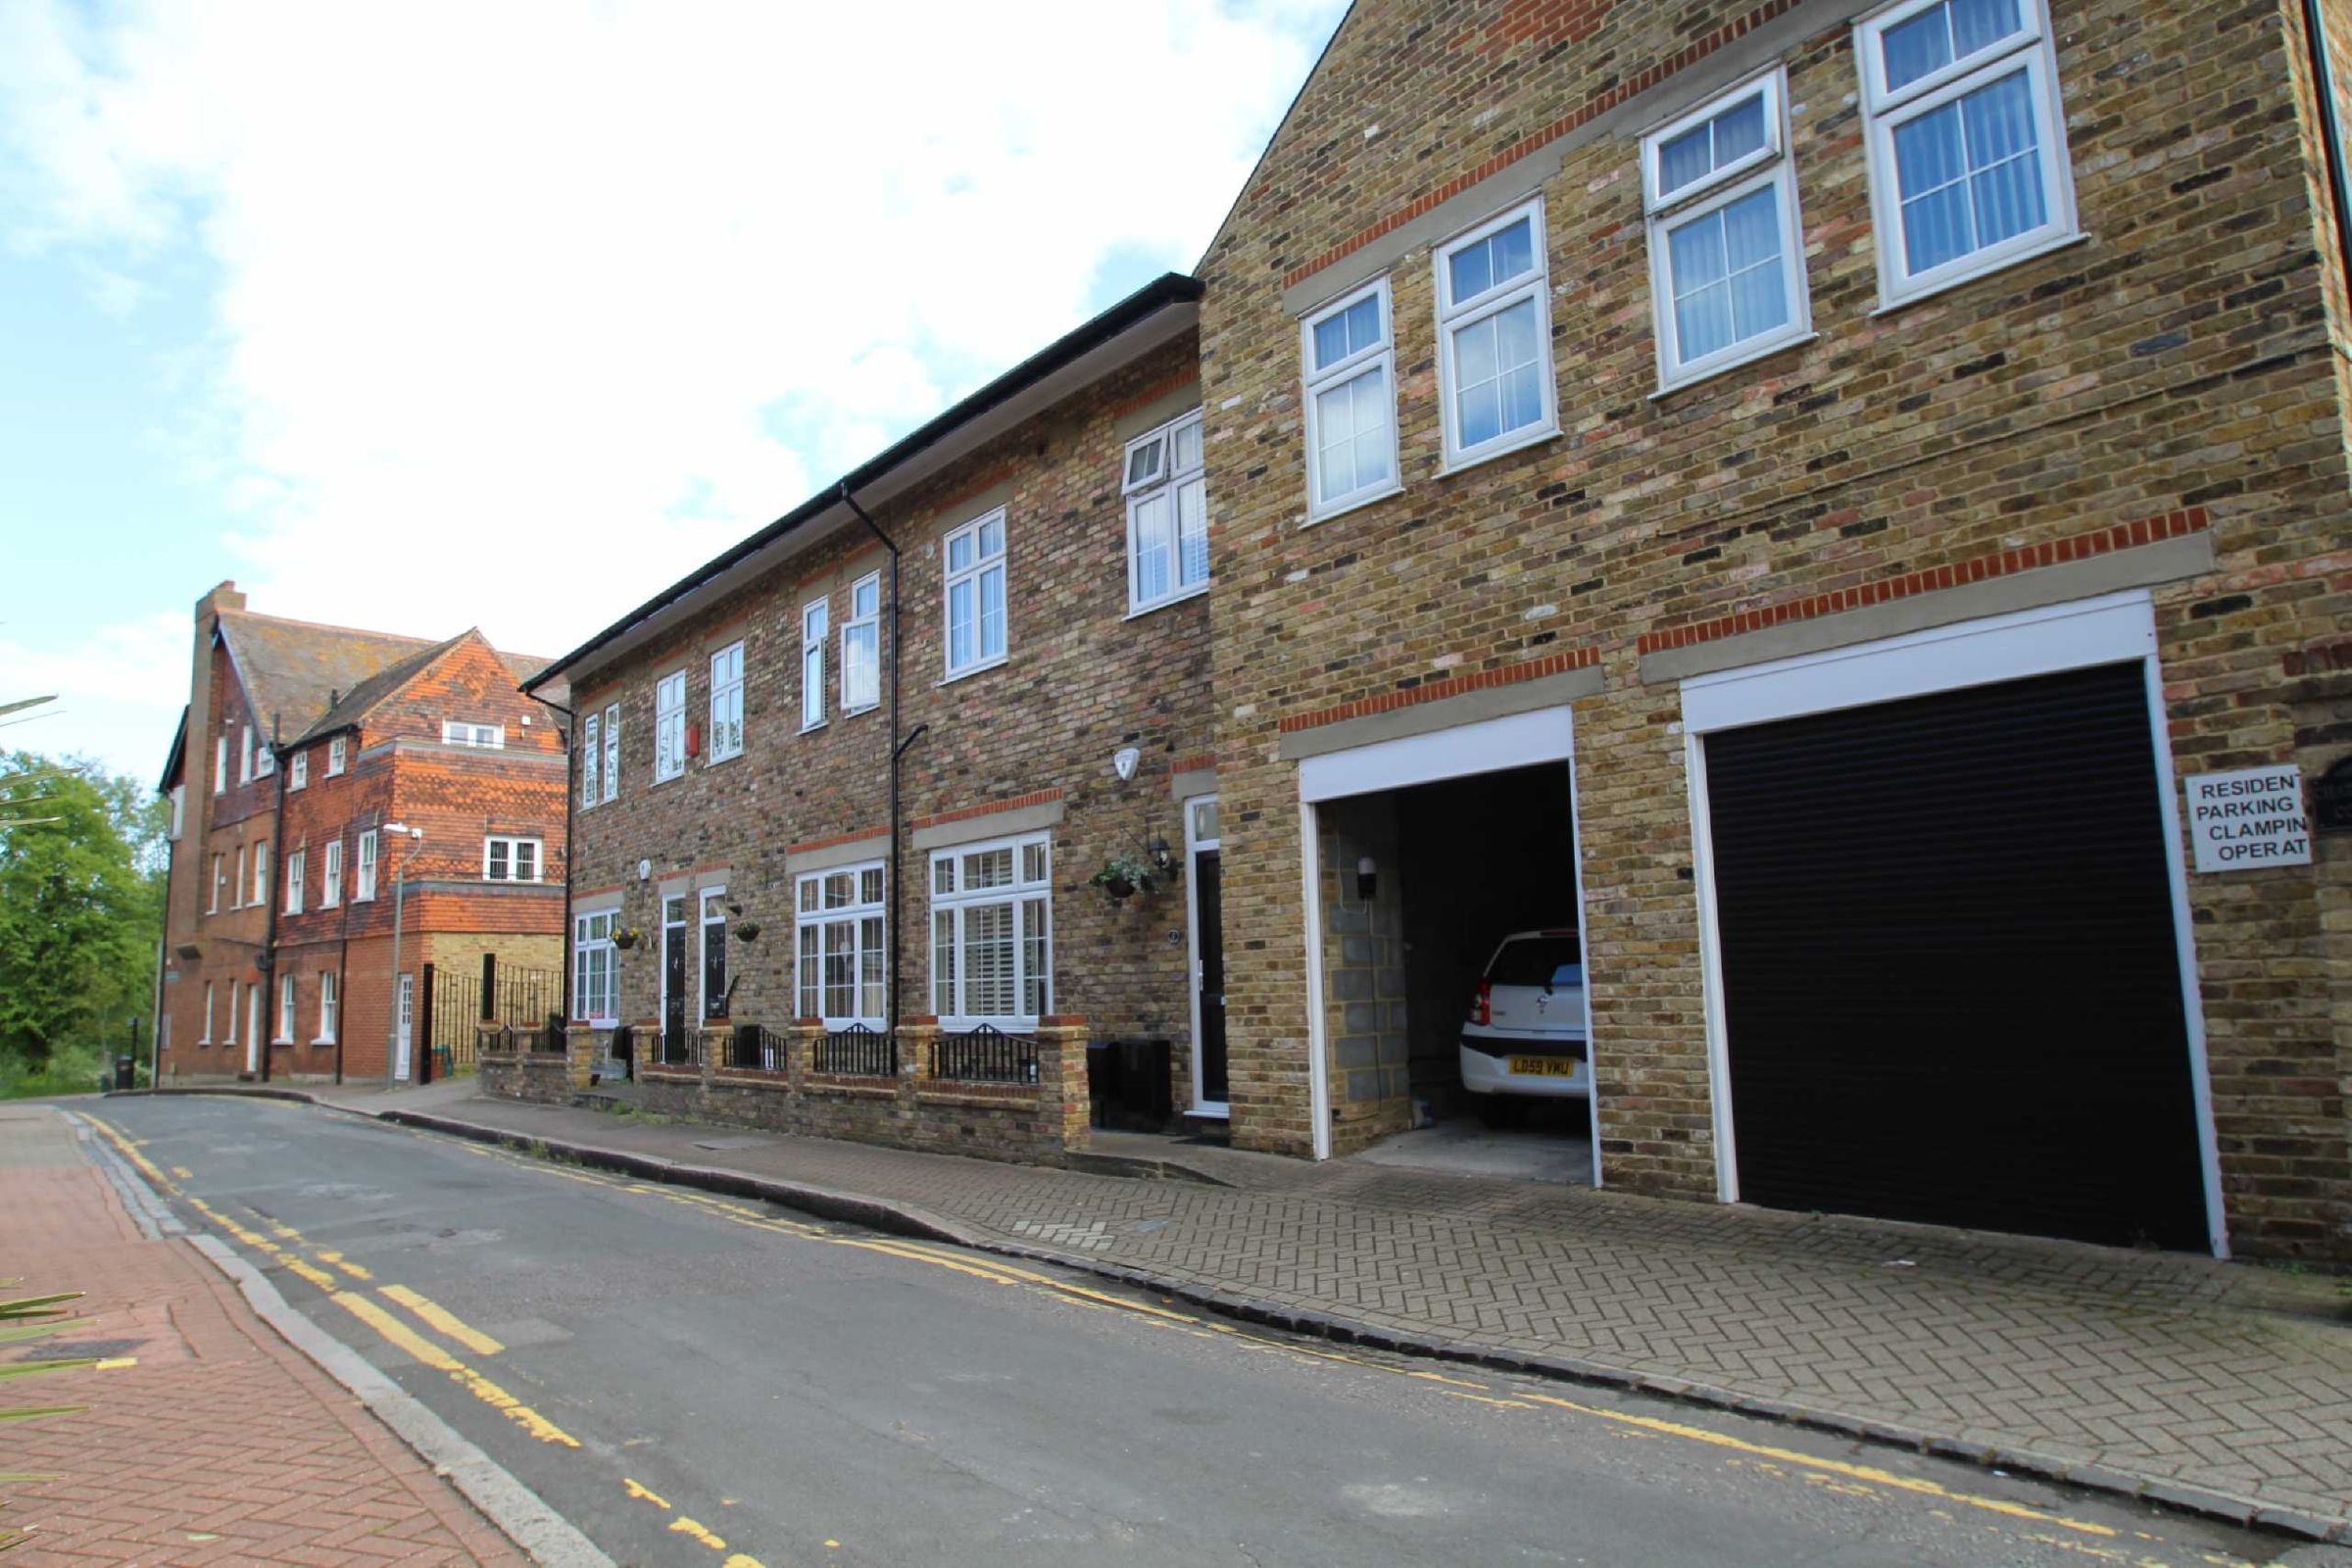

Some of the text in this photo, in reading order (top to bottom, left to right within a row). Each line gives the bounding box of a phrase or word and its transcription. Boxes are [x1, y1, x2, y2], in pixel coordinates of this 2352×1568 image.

[2201, 774, 2300, 799] RESIDEN
[2196, 797, 2293, 820] PARKING
[2209, 817, 2307, 840] CLAMPIN
[2219, 839, 2306, 860] OPERAT
